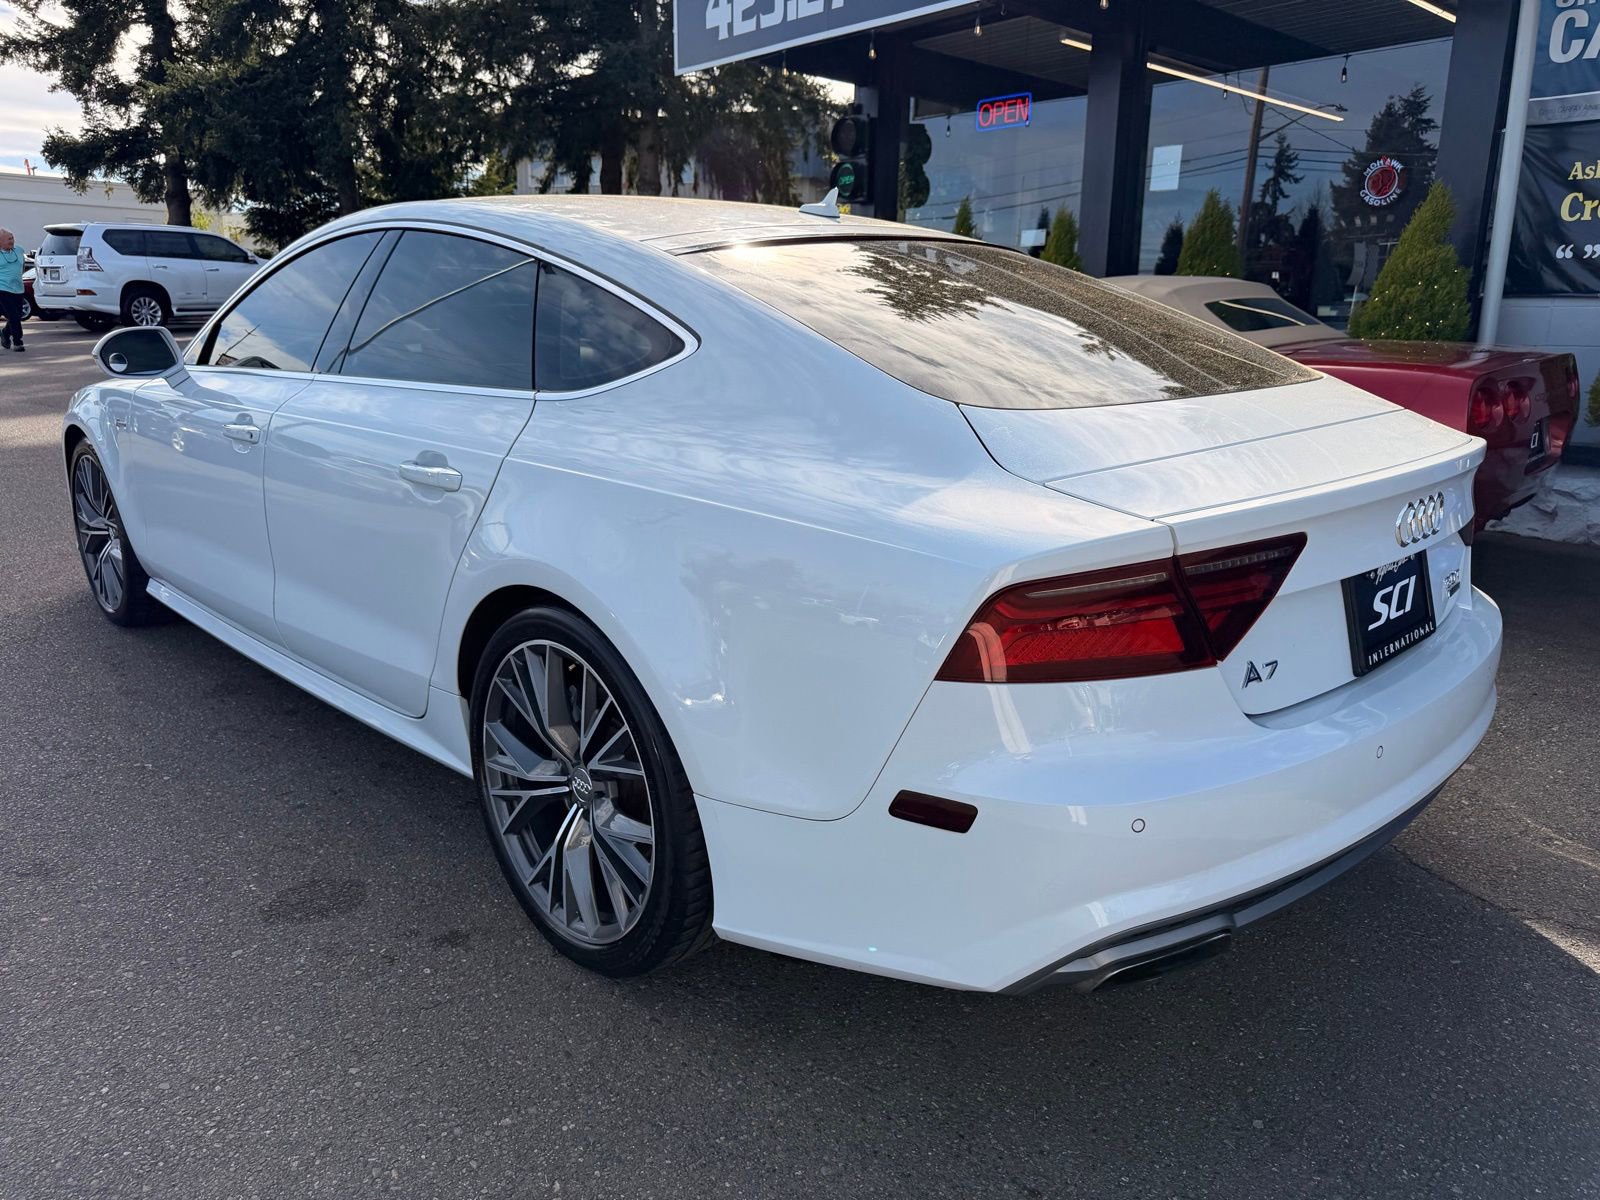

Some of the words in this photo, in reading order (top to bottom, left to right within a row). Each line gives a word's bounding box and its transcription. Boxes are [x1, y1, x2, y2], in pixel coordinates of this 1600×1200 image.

[979, 96, 1029, 127] OPEN
[1363, 157, 1405, 176] MOHAWK
[1359, 187, 1402, 207] GASOLINE
[1560, 192, 1600, 222] Cr
[1367, 574, 1417, 632] SCI
[1367, 620, 1435, 666] INTERNATIONAL
[1241, 659, 1279, 690] A7
